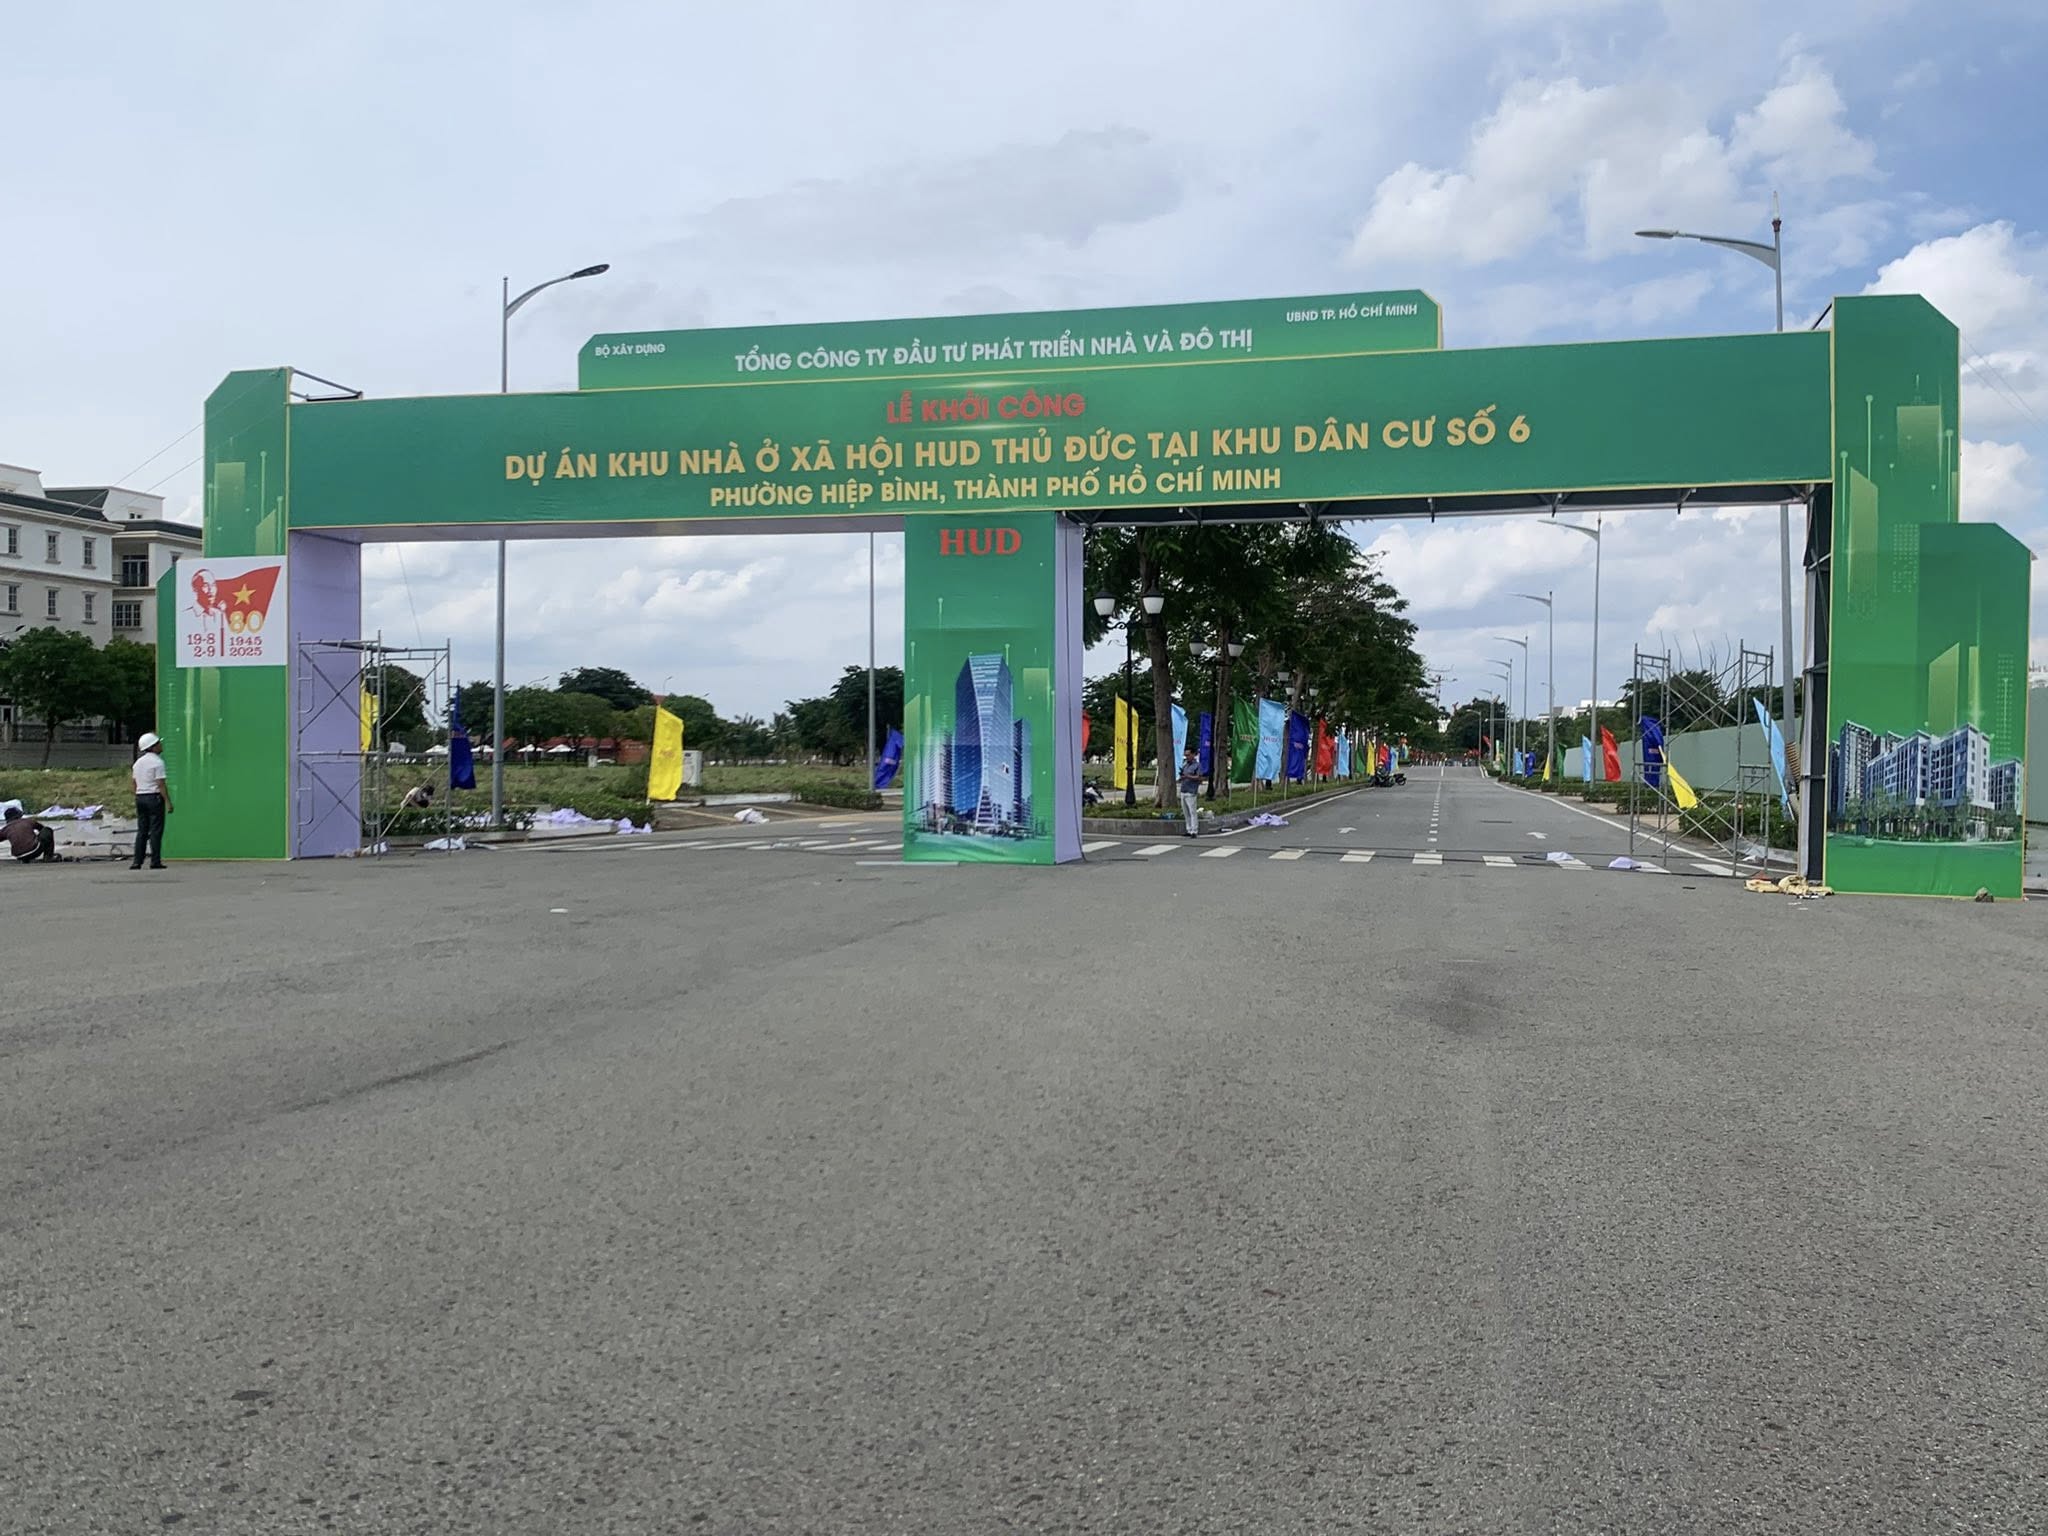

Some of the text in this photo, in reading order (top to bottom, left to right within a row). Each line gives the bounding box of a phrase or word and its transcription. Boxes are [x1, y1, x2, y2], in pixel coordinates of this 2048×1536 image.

[1287, 311, 1318, 322] UBND
[1321, 309, 1335, 319] TP.
[1361, 304, 1383, 317] CHÍ
[1386, 304, 1417, 315] MINH
[595, 343, 665, 358] BỘ XÂY DỰNG
[735, 327, 1252, 371] TỔNG CÔNG TY ĐẦU TƯ PHÁT TRIỂN NHÀ VÀ ĐÔ THỊ
[887, 388, 1086, 423] LỄ KHỞI CÔNG
[506, 405, 1530, 486] DỰ ÁN KHU NHÀ Ở XÃ HỘI HUD THỦ ĐỨC TẠI KHU DÂN CƯ SỐ 6
[711, 464, 1280, 508] PHƯỜNG HIỆP BÌNH, THÀNH PHỐ HỒ CHÍ MINH
[940, 528, 1021, 555] HUD
[229, 610, 264, 634] 80
[187, 633, 216, 646] 19-8
[229, 636, 262, 647] 1945
[193, 646, 216, 657] 2-9
[229, 647, 262, 657] 2025
